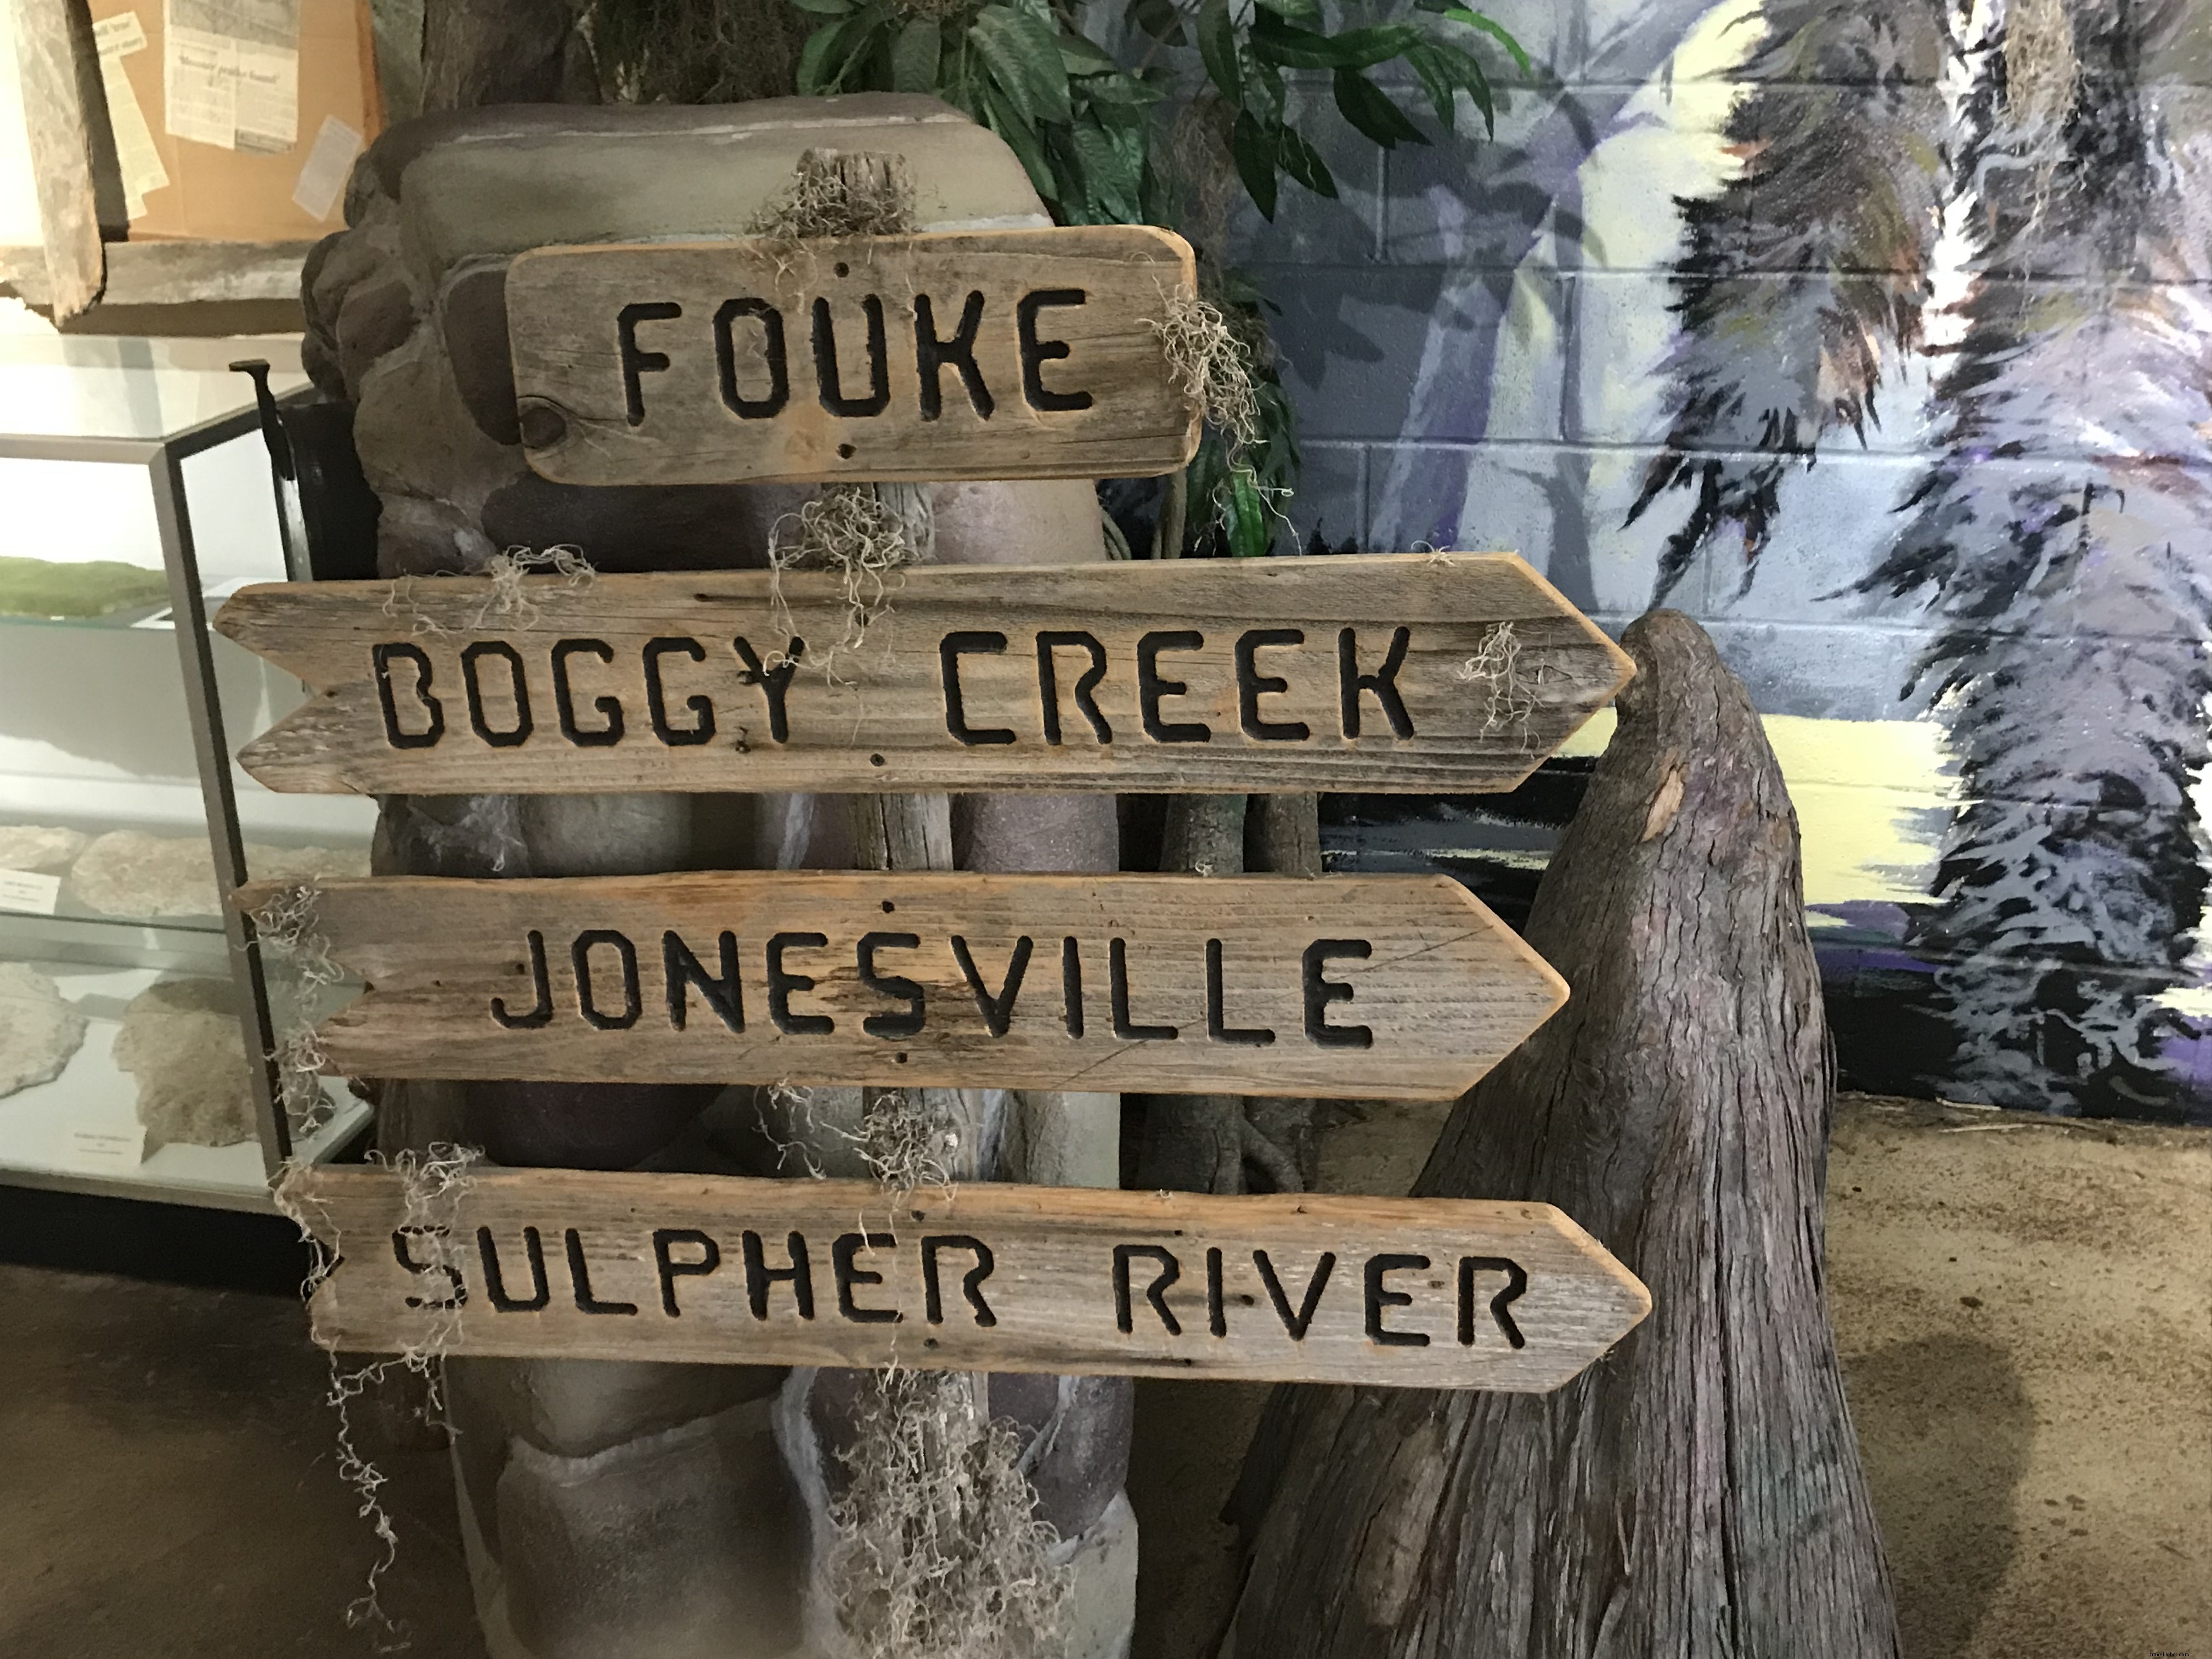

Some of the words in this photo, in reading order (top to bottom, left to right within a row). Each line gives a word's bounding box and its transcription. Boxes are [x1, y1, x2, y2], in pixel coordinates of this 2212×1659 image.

[617, 288, 1093, 427] FOUKE
[372, 636, 805, 748] BOGGY
[939, 627, 1414, 744] CREEK
[490, 929, 1373, 1048] JONESVILLE
[392, 1226, 996, 1327] SULPHER
[1112, 1244, 1528, 1349] RIVER
